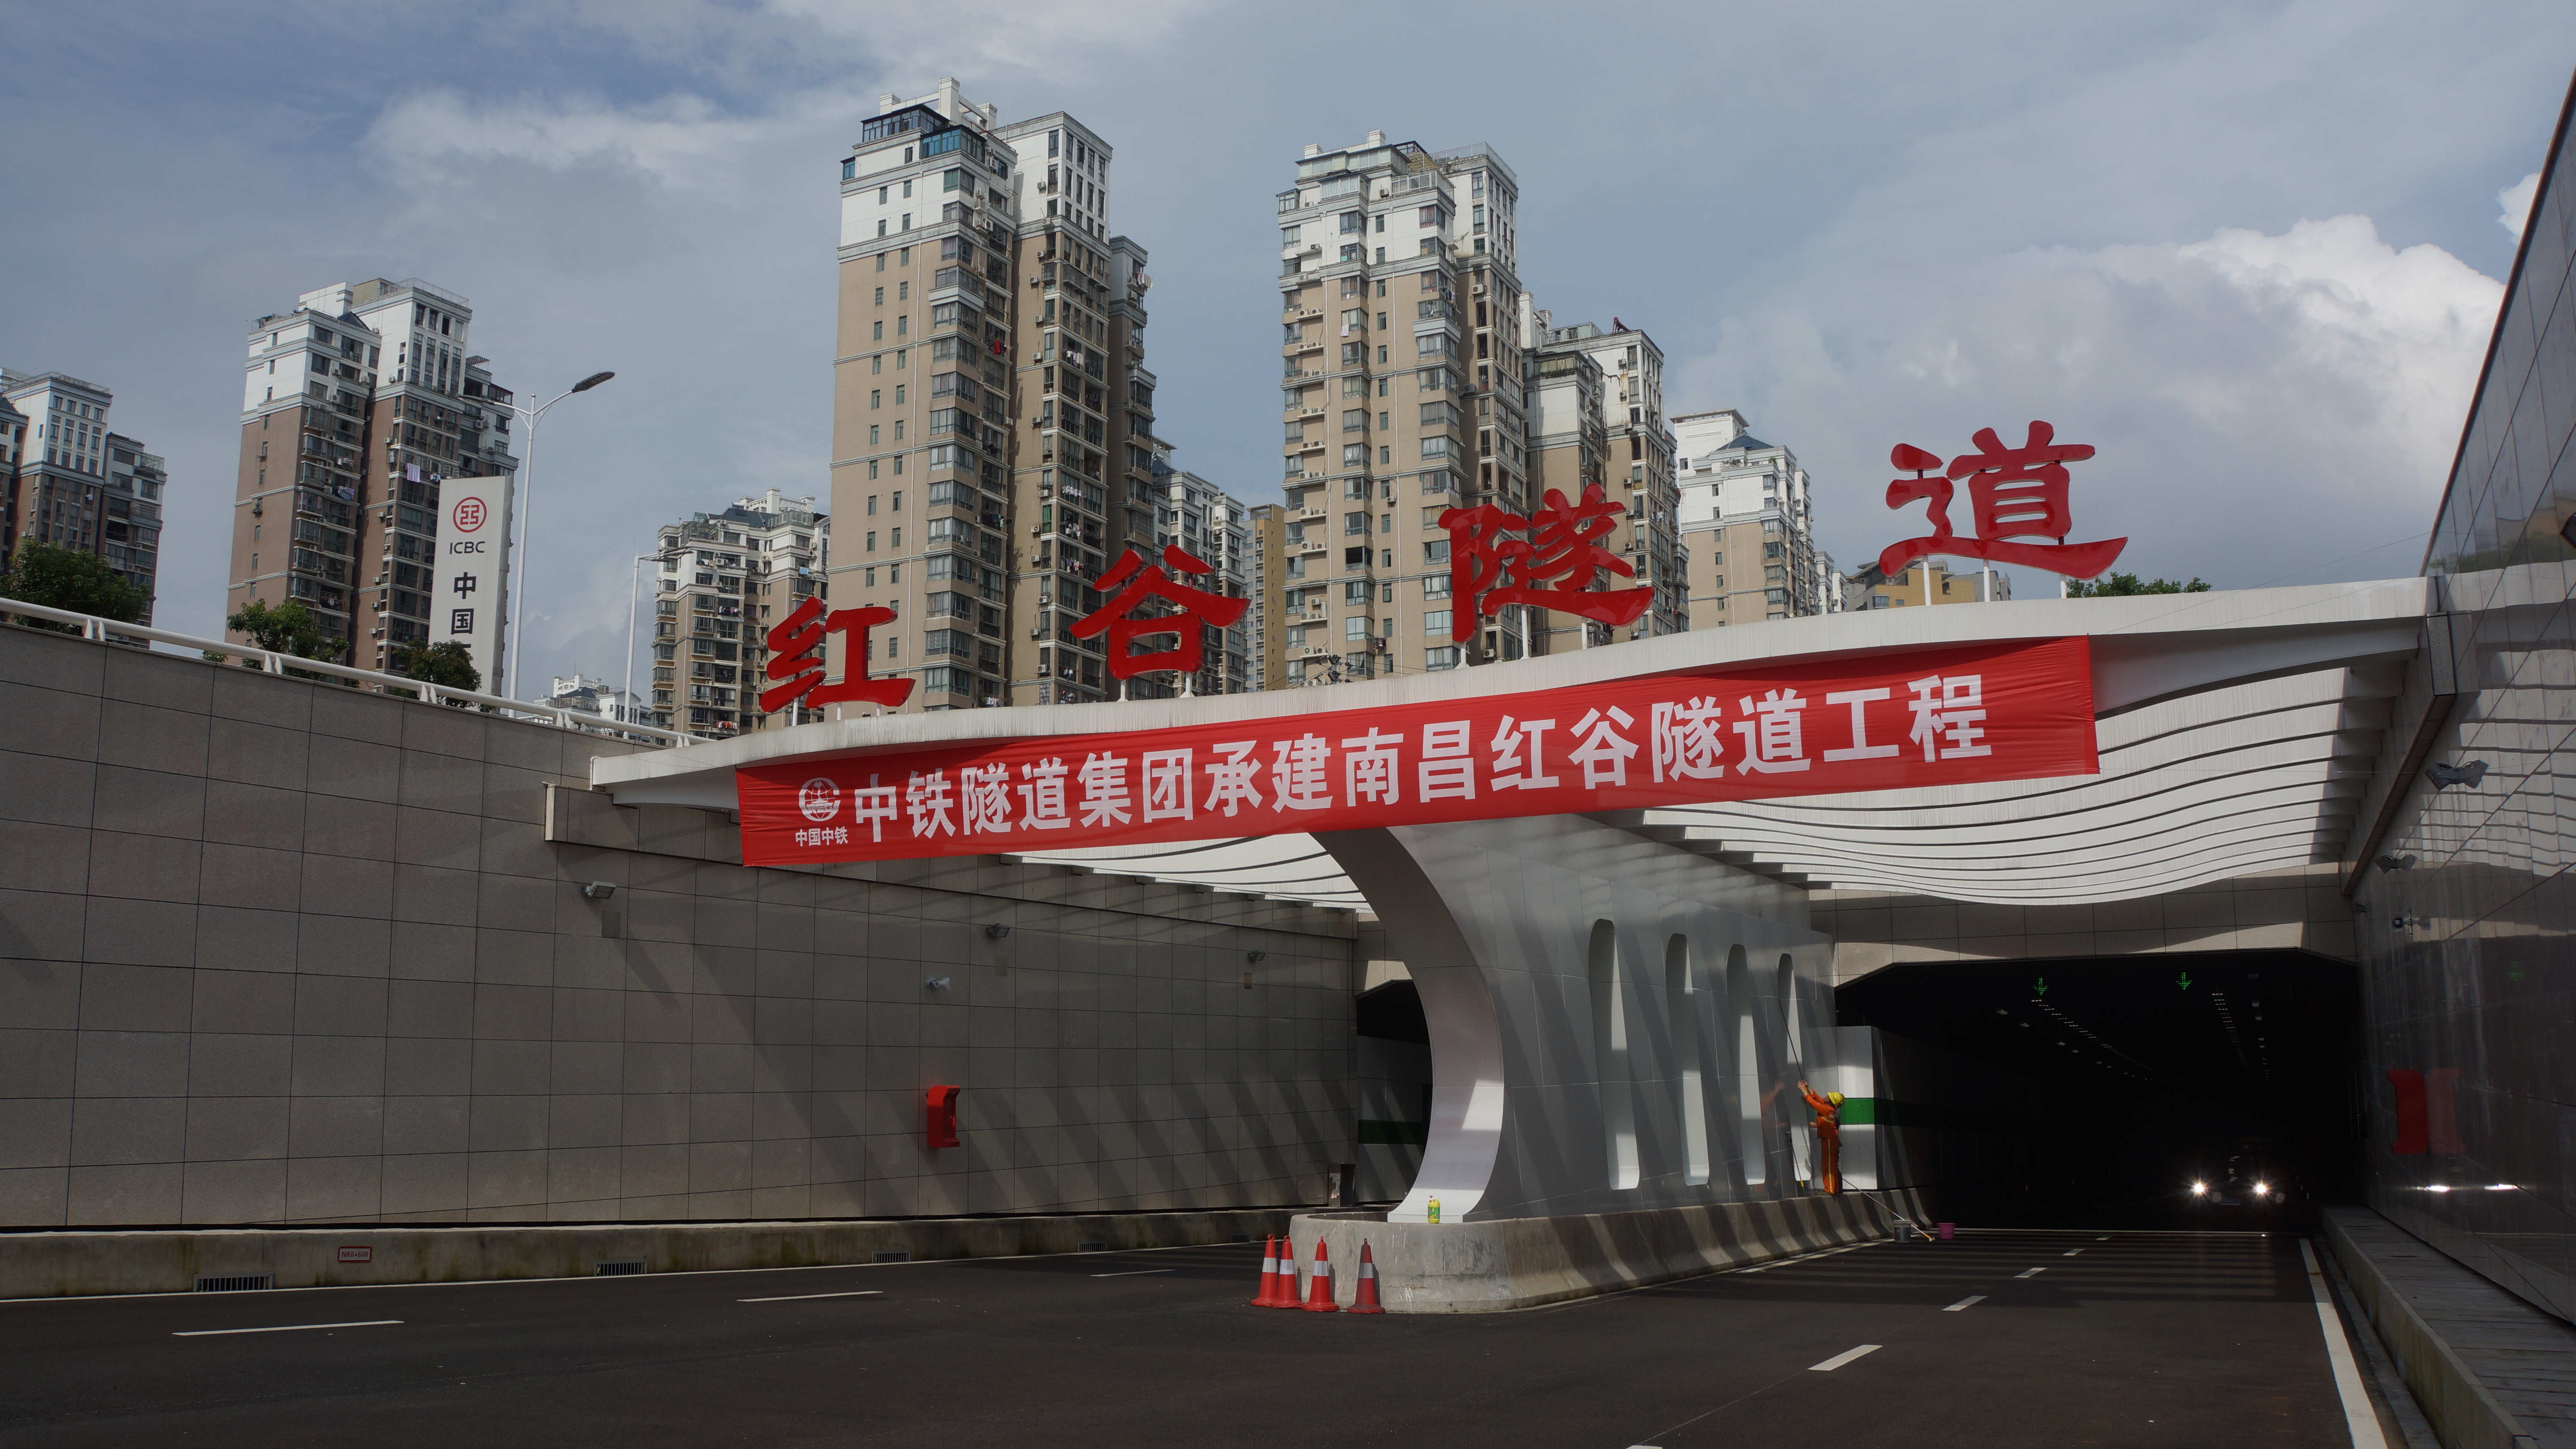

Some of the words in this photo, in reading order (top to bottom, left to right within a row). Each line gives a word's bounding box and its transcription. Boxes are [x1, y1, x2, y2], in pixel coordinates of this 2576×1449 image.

[450, 541, 486, 555] ICBC
[760, 420, 2128, 712] 红谷隧道
[450, 571, 477, 649] 中国
[854, 674, 1992, 843] 中铁隧道集团承建南昌红谷隧道工程
[795, 826, 848, 847] 中国中铁
